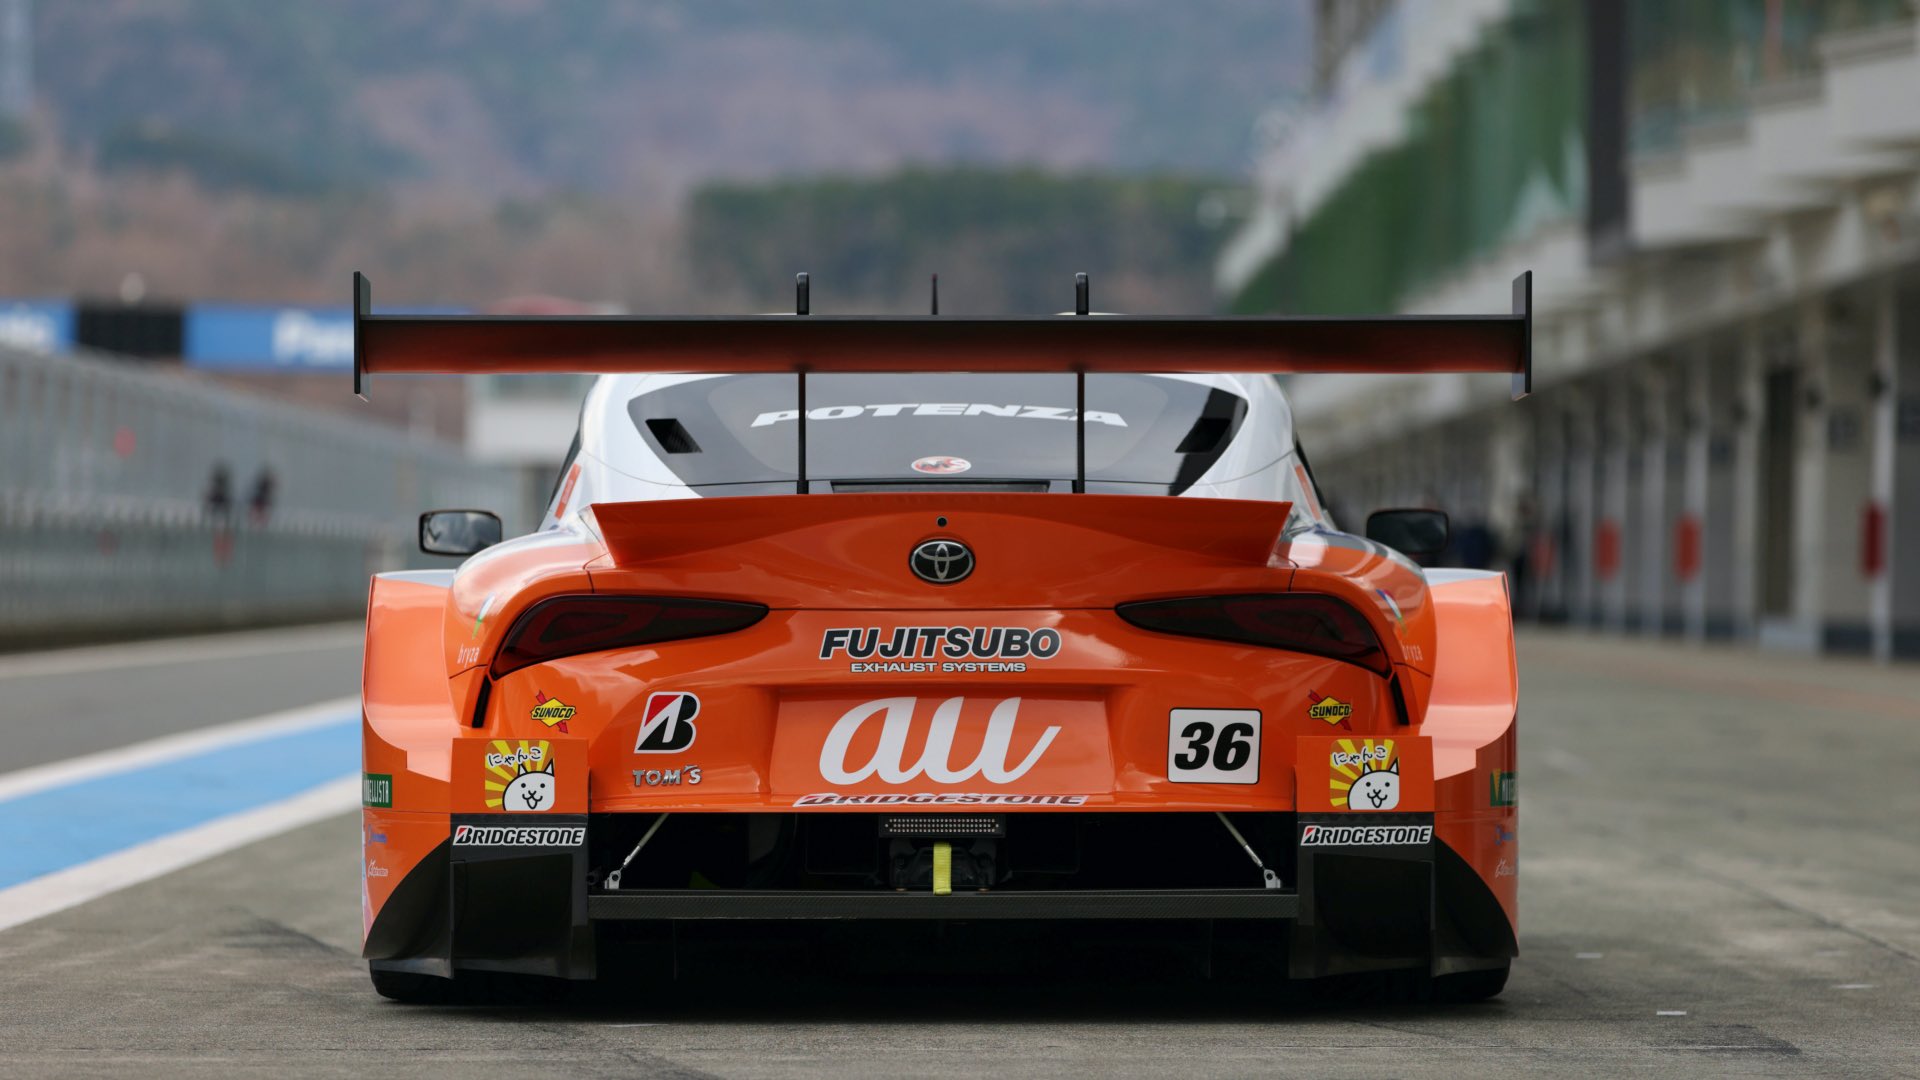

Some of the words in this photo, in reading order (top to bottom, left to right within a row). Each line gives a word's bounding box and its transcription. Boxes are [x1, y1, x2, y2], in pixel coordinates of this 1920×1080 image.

[751, 403, 1128, 428] POTENZA
[819, 626, 1061, 660] FUJITSUBO
[851, 662, 938, 673] EXHAUST
[942, 662, 1026, 673] SYSTEMS
[532, 707, 574, 718] SUNOCO
[1311, 705, 1351, 717] SUNOCO
[819, 696, 1062, 785] au
[1174, 721, 1255, 771] 36
[487, 746, 543, 766] にゃんこ
[1331, 744, 1388, 765] にゃんこ
[633, 765, 702, 786] TOM'S
[793, 793, 1088, 807] BRIDGESTONE
[452, 825, 585, 846] BRIDGESTONE
[1301, 824, 1433, 846] BRIDGESTONE
